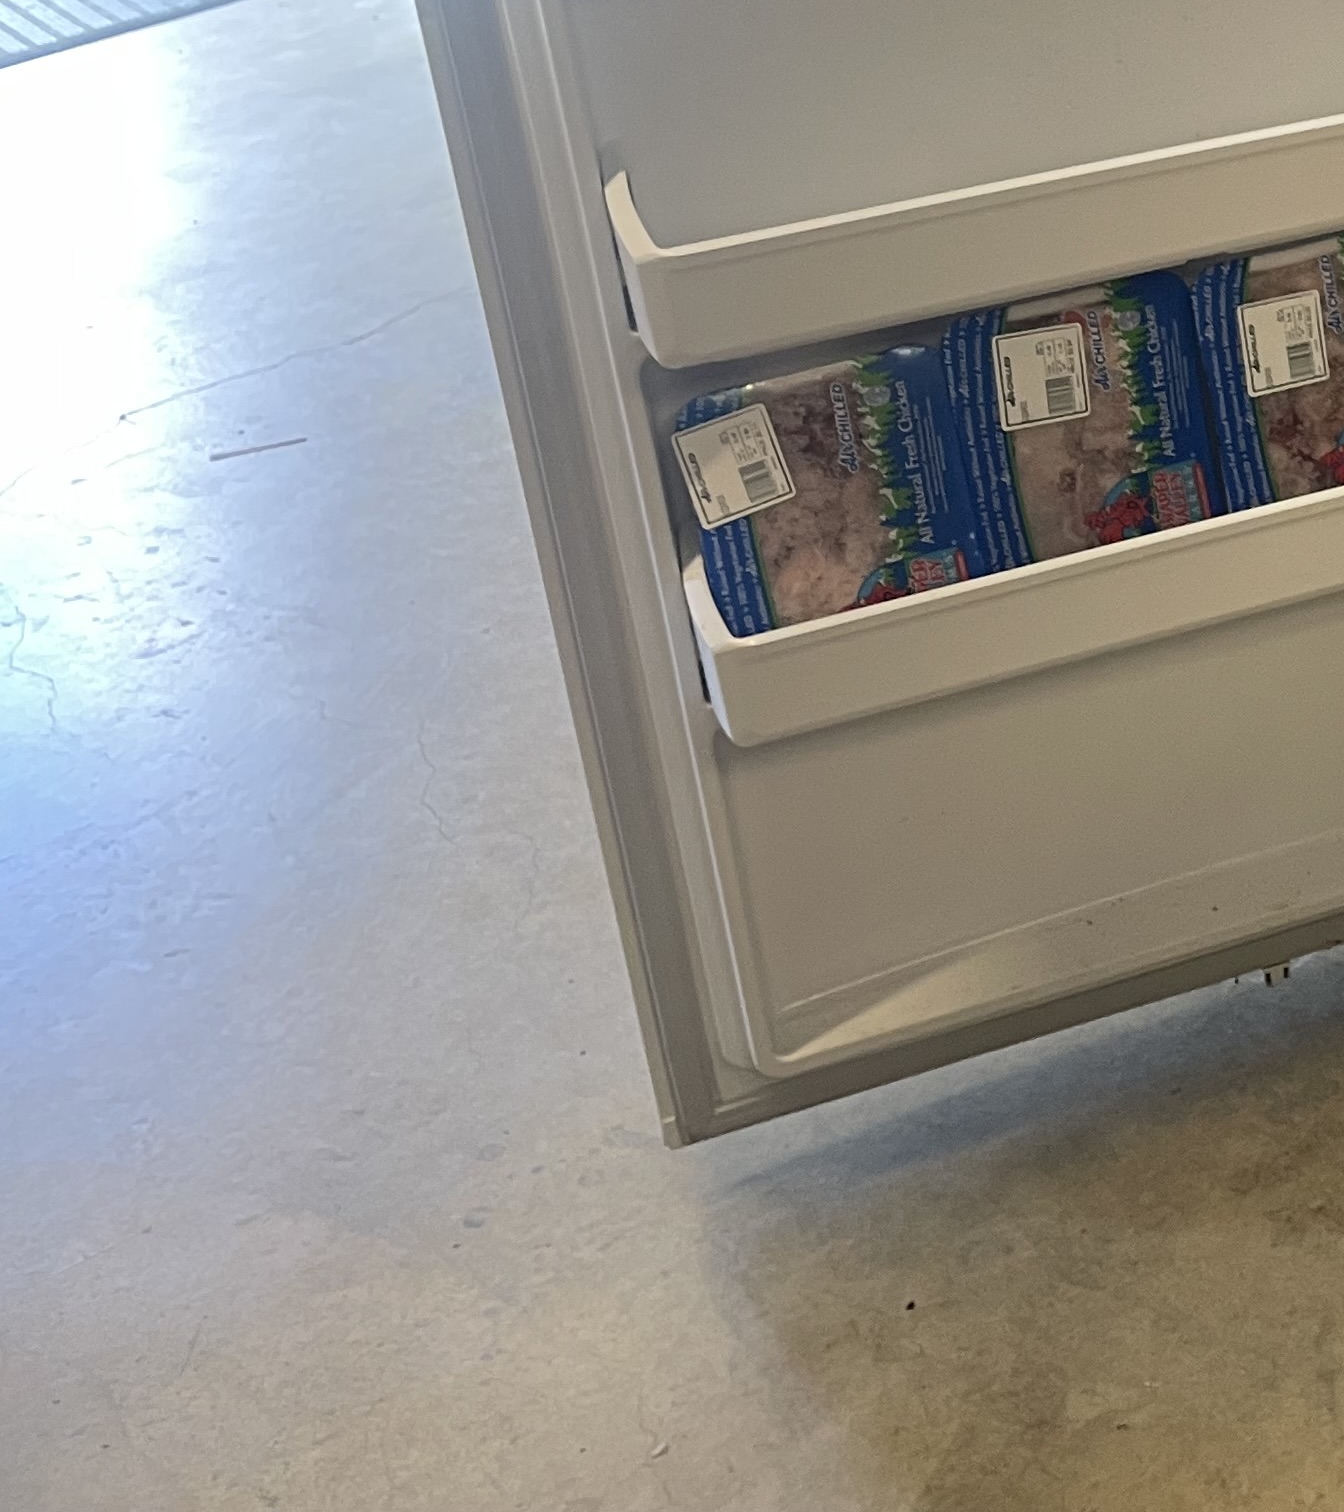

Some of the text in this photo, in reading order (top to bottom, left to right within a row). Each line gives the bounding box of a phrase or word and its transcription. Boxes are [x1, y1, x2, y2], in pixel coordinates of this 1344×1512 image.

[1319, 255, 1338, 309] CHILLED
[1086, 311, 1107, 367] CHILLED
[1151, 354, 1166, 389] Fresh
[831, 383, 853, 450] CHILLED
[1153, 390, 1172, 438] Natural
[902, 434, 920, 470] Fresh
[1161, 438, 1176, 457] All
[912, 472, 930, 524] Natural
[920, 526, 935, 545] All
